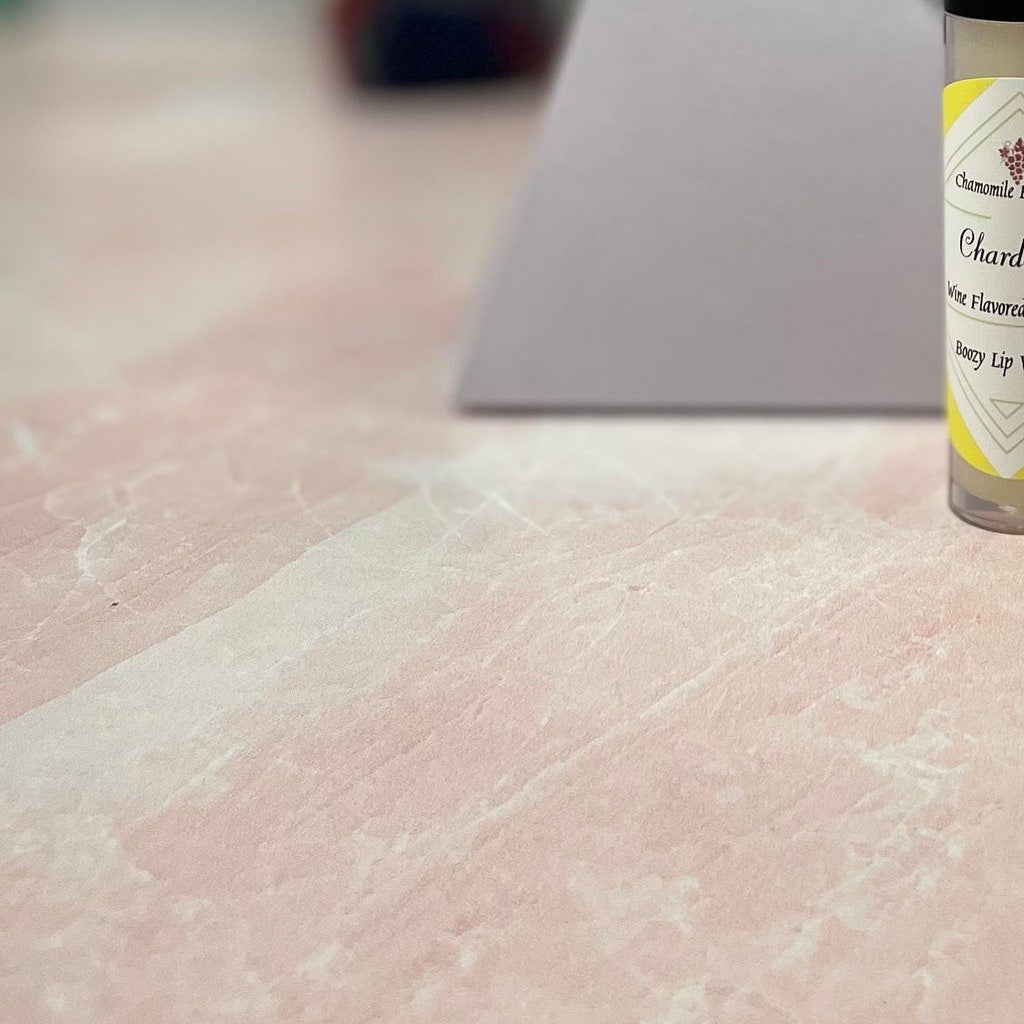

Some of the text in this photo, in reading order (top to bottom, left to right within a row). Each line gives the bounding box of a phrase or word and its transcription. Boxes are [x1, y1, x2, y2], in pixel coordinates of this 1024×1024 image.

[955, 171, 1014, 199] Chamomile
[947, 280, 967, 306] Wine
[955, 340, 986, 371] Boozy
[991, 351, 1014, 377] Lip
